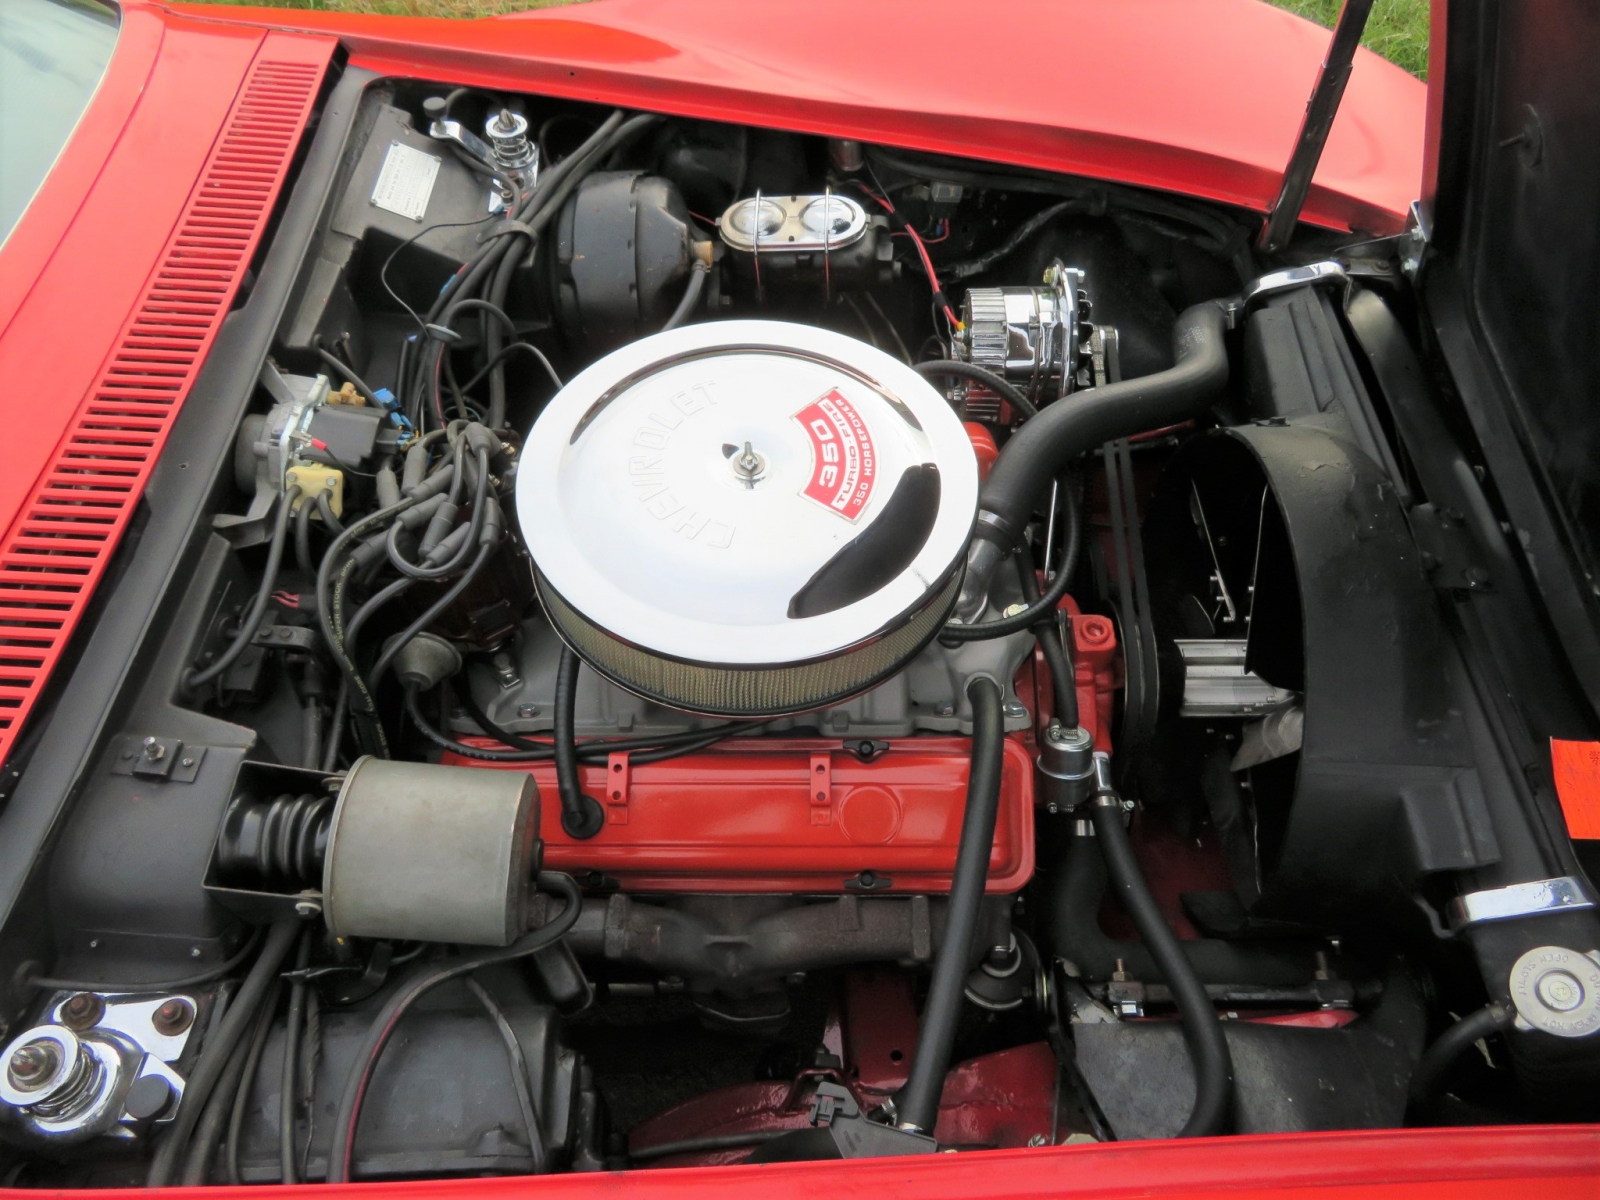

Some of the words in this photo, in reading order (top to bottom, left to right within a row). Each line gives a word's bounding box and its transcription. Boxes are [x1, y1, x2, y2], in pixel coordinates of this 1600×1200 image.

[628, 379, 736, 549] CHEVROLET
[810, 418, 839, 488] 350
[821, 401, 857, 504] TURBO-FIRE
[835, 398, 873, 476] HORSEPOWER
[852, 483, 869, 506] 350
[333, 582, 342, 609] STOCK
